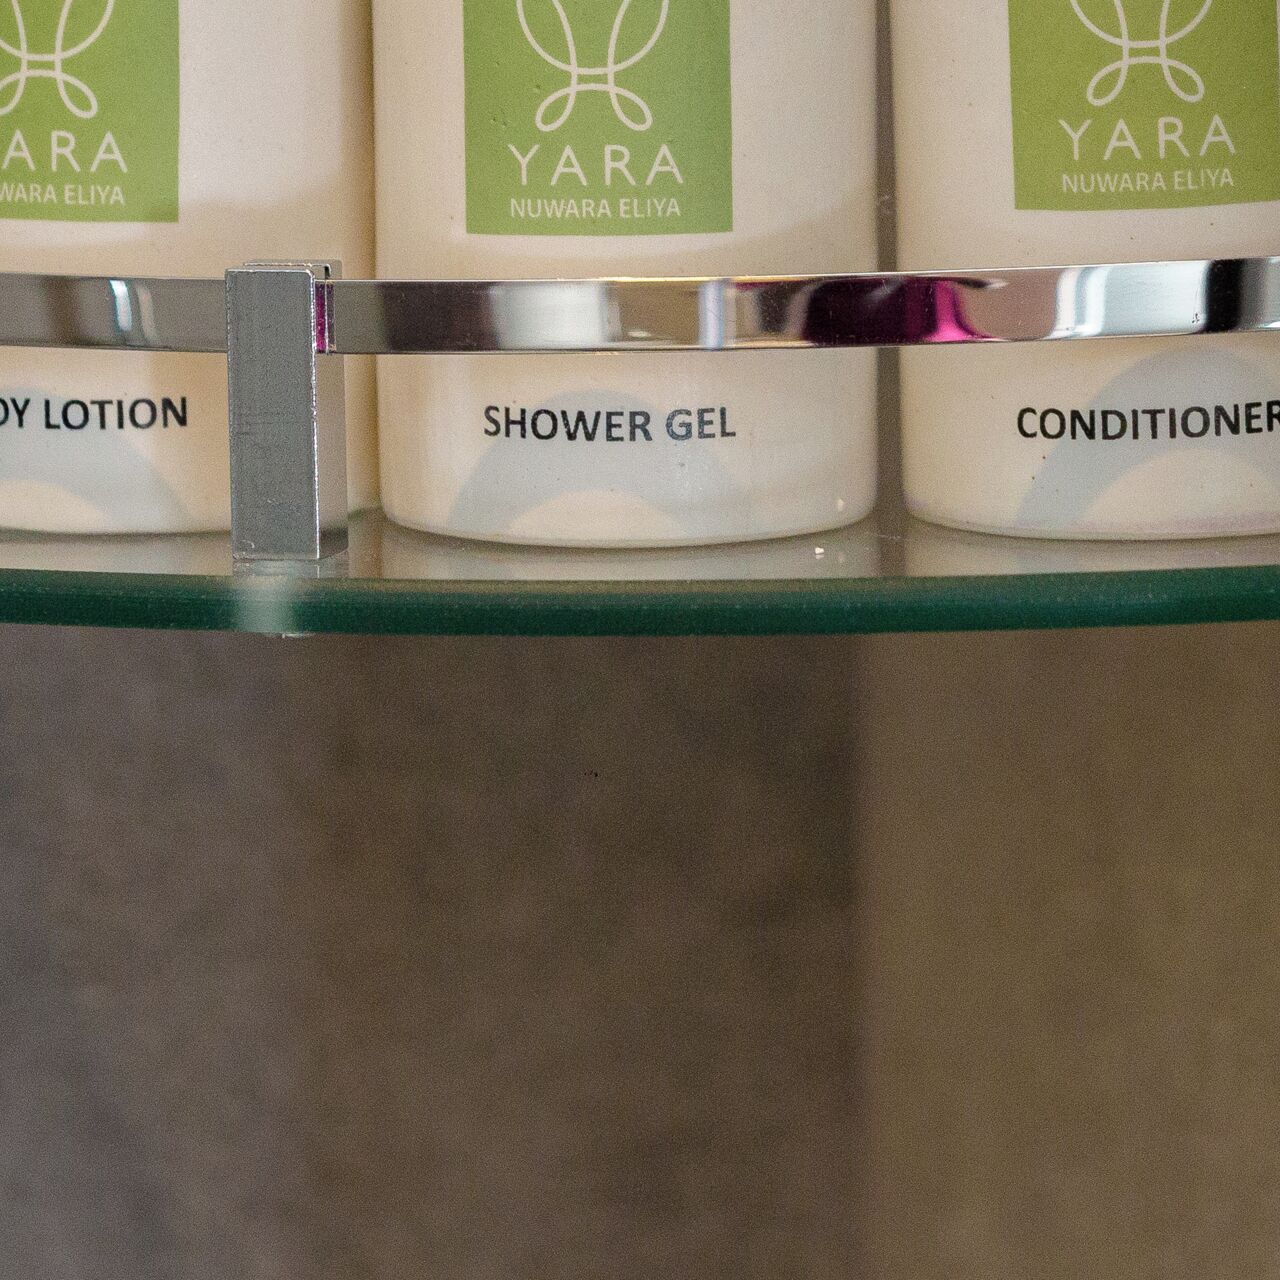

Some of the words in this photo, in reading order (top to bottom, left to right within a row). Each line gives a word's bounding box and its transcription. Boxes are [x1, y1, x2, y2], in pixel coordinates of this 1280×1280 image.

[1058, 113, 1236, 161] YARA
[507, 143, 684, 186] YARA
[1062, 171, 1167, 194] NUWARA
[1173, 167, 1235, 191] ELIYA
[63, 183, 126, 206] ELIYA
[510, 197, 612, 219] NUWARA
[619, 197, 682, 219] ELIYA
[44, 396, 188, 430] LOTION
[483, 405, 653, 442] SHOWER
[665, 406, 737, 441] GEL
